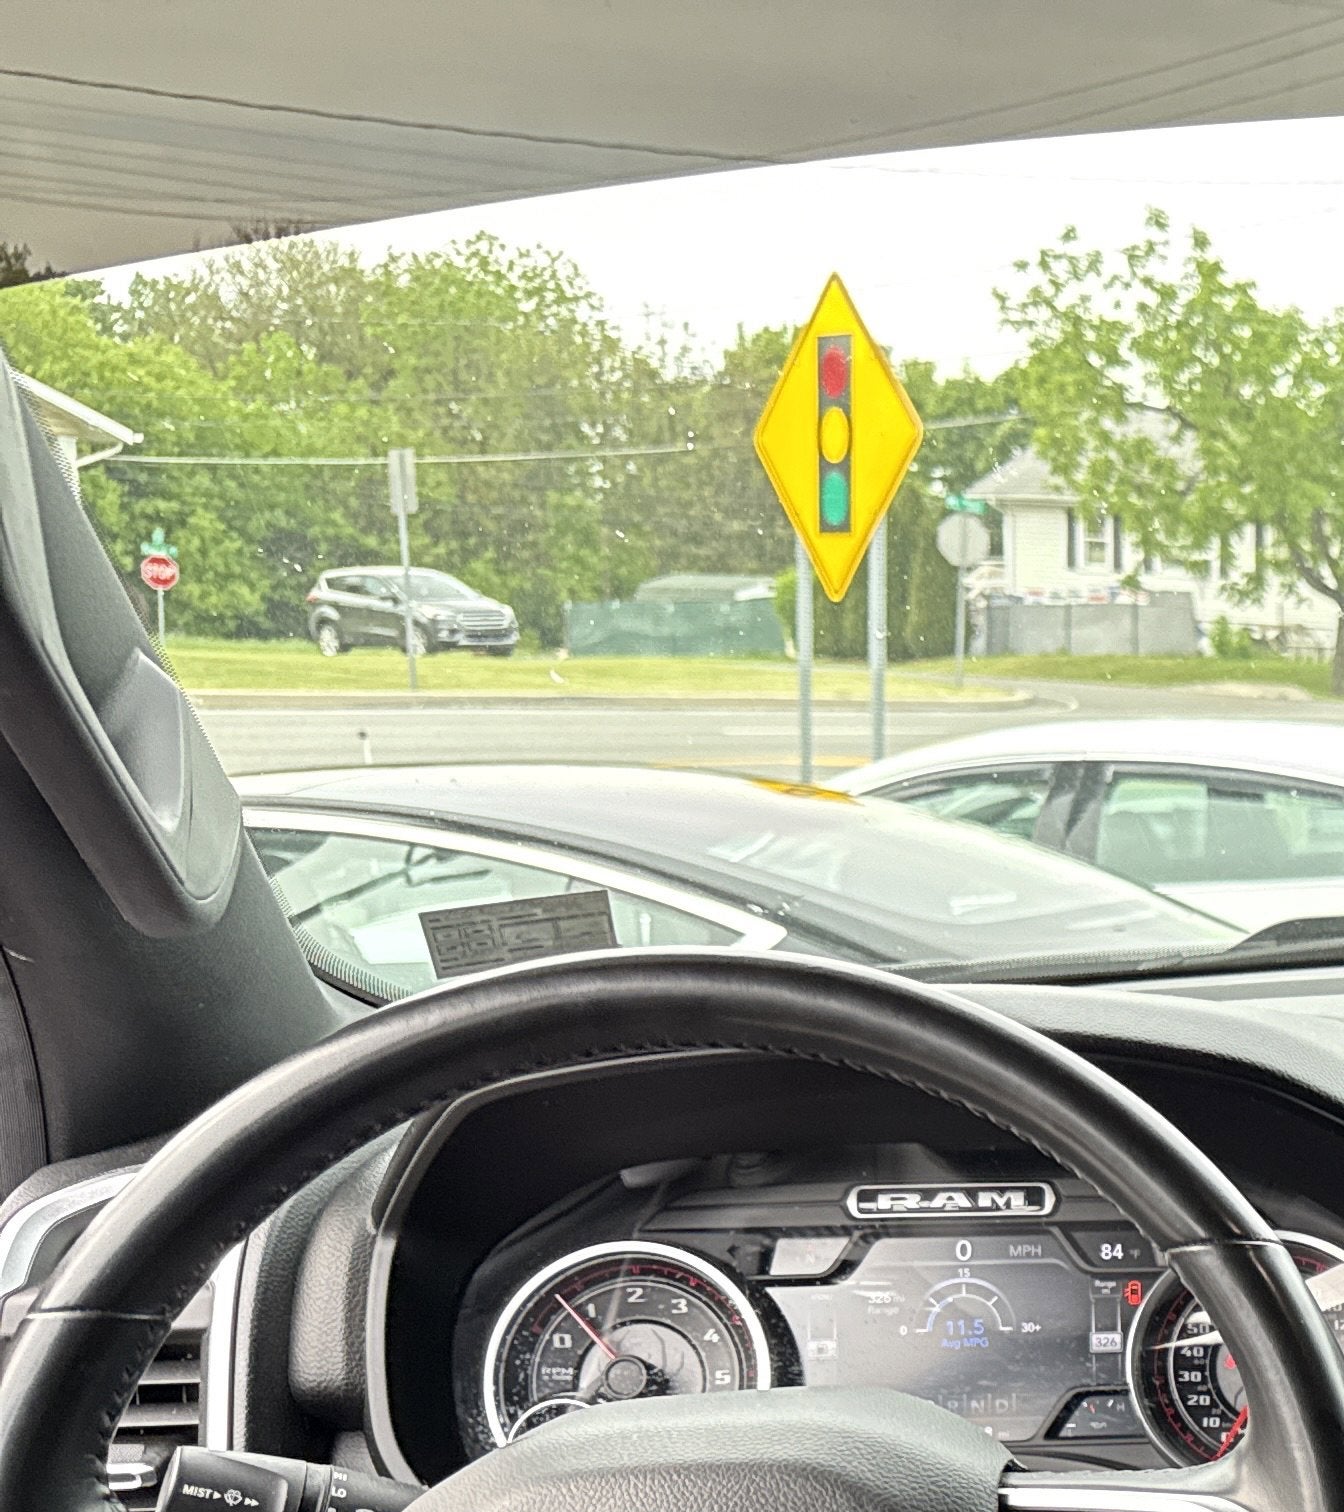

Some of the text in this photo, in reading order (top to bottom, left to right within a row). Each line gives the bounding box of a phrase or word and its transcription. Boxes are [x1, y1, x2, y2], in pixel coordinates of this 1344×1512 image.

[877, 1191, 1026, 1211] RAM
[955, 1239, 1042, 1262] 0 MPH
[1100, 1243, 1124, 1260] 84
[958, 1268, 970, 1278] 15
[626, 1287, 645, 1303] 2
[586, 1303, 597, 1318] 1
[671, 1299, 688, 1314] 3
[899, 1319, 1042, 1336] 0 11.5 30+
[552, 1333, 573, 1349] 0
[703, 1329, 720, 1343] 4
[1094, 1336, 1118, 1347] 326
[1180, 1346, 1204, 1357] 40
[715, 1369, 731, 1385] 5
[1178, 1371, 1202, 1382] 30
[1187, 1394, 1211, 1406] 20
[1202, 1417, 1221, 1427] 10
[182, 1483, 212, 1500] MIST
[331, 1486, 347, 1498] LO
